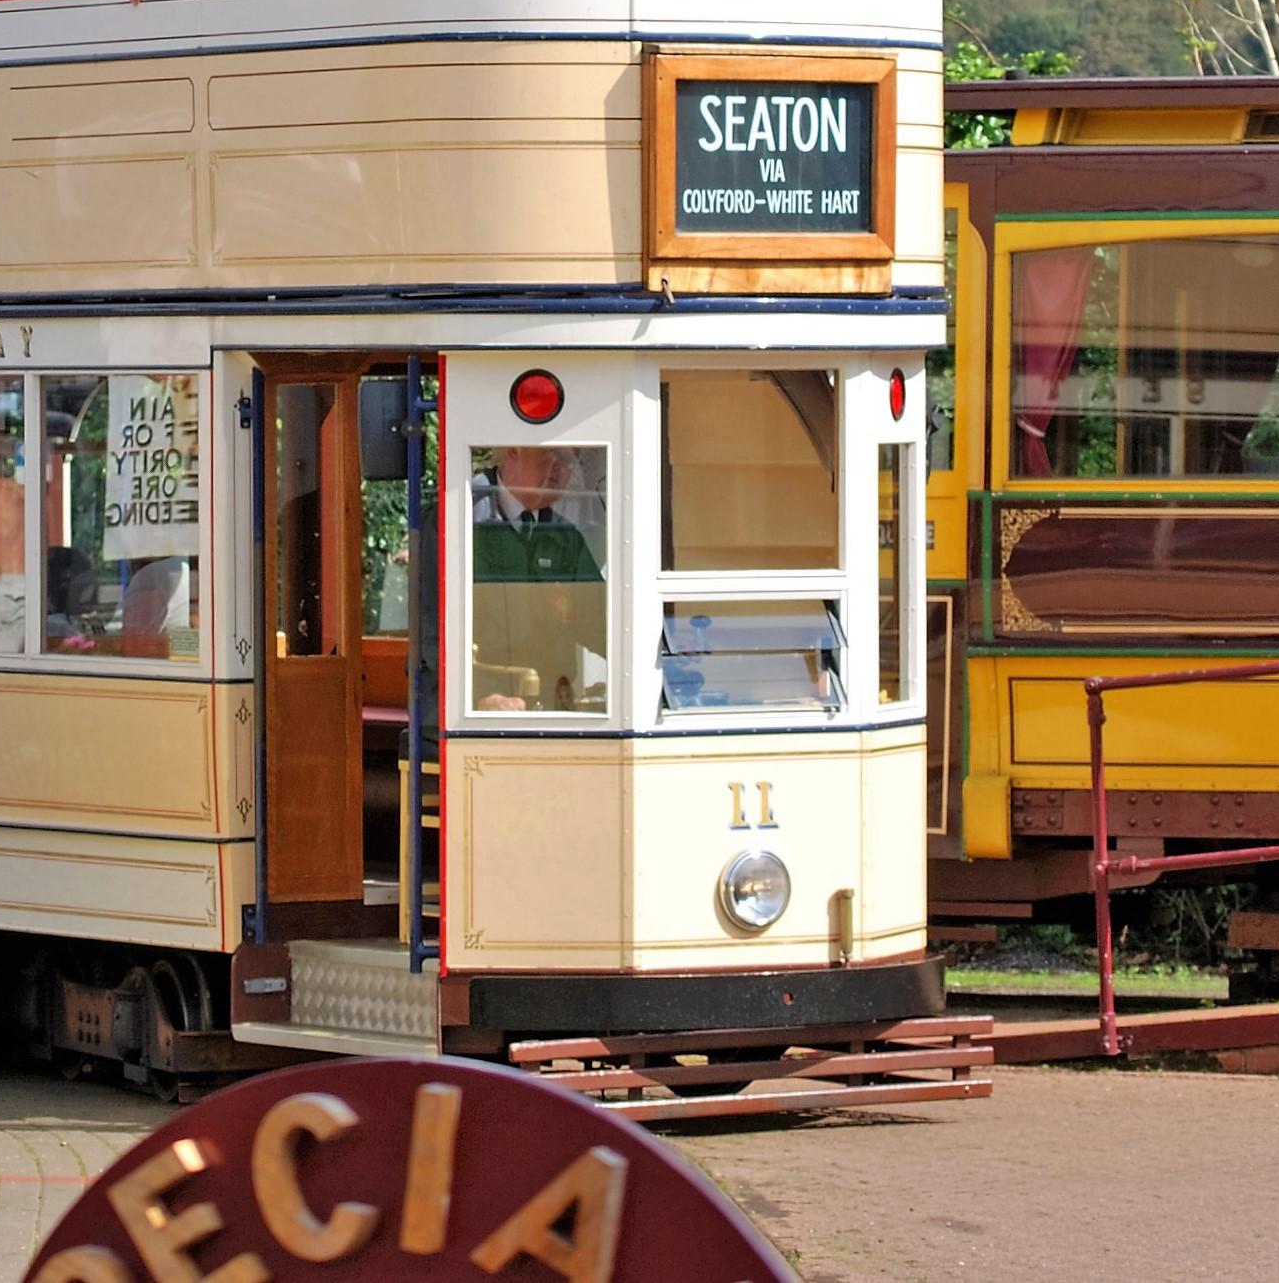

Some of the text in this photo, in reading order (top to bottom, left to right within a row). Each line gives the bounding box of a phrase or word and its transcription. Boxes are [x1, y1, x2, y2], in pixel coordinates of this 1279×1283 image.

[698, 95, 847, 152] SEATON
[759, 159, 785, 182] VIA
[822, 190, 860, 214] HART
[727, 781, 780, 830] 11
[25, 1082, 629, 1283] ECIA
